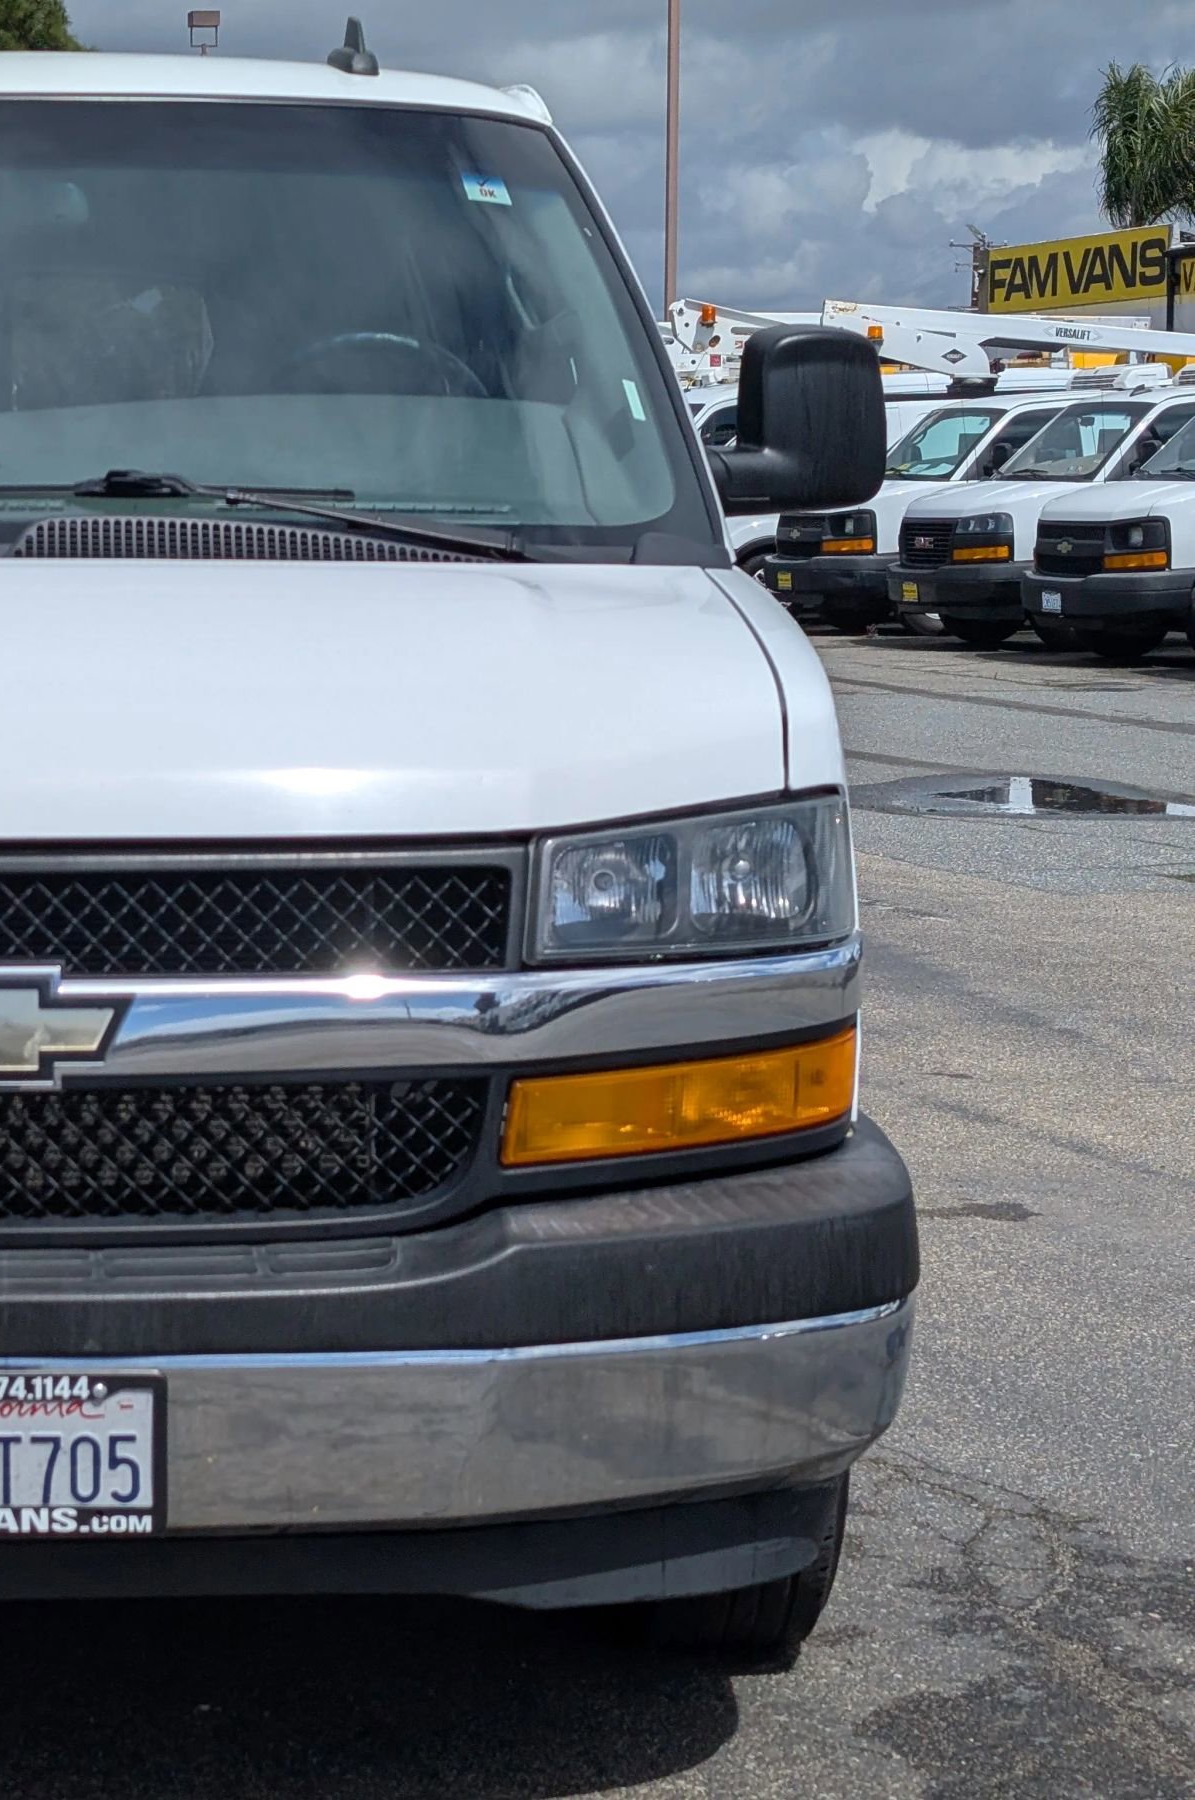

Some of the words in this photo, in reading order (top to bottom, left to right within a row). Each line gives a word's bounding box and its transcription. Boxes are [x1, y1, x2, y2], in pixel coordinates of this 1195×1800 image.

[479, 188, 497, 198] OK
[989, 252, 1058, 303] FAM
[1063, 238, 1167, 295] VANS
[1055, 327, 1091, 341] VERSALIFT
